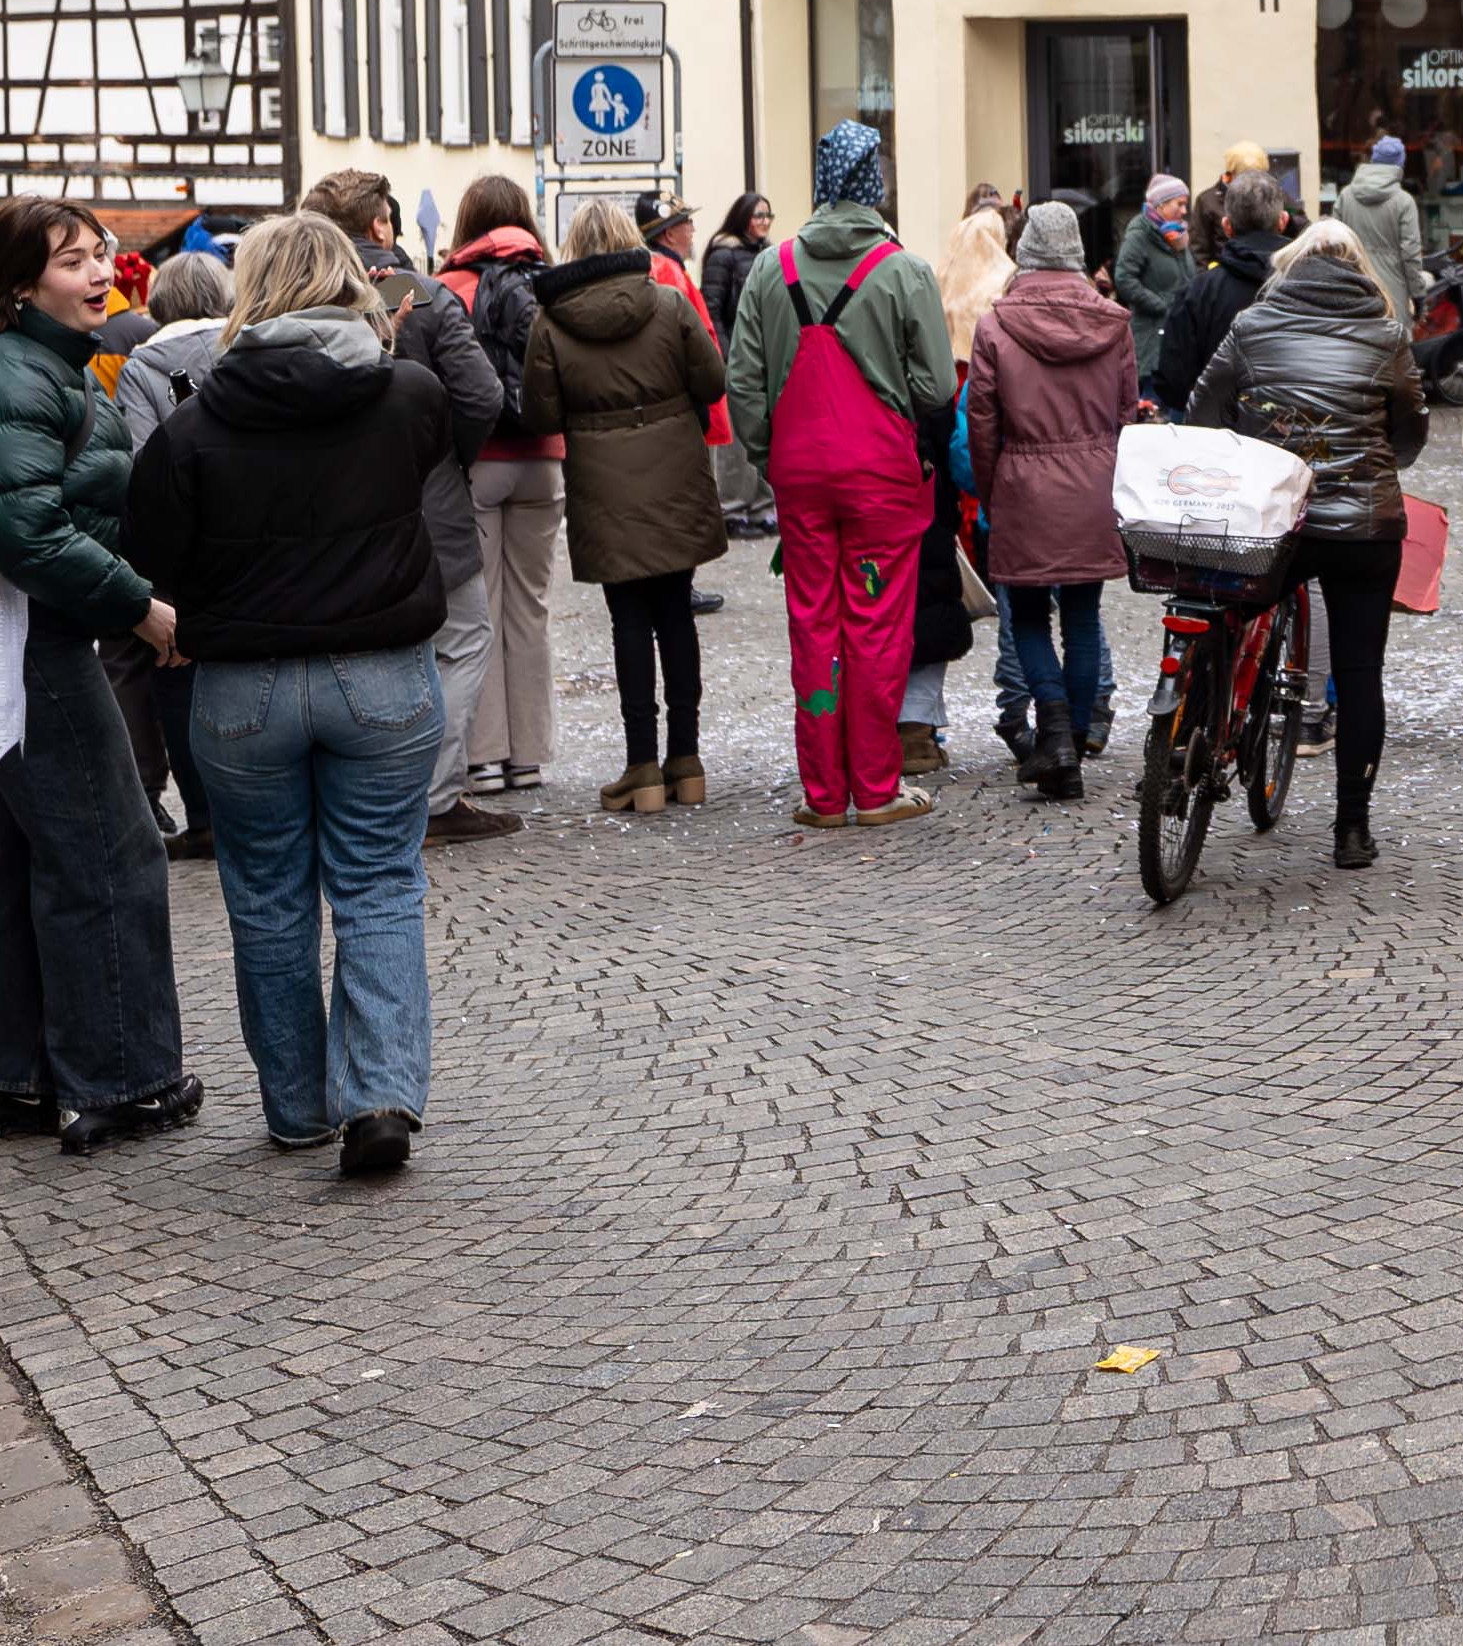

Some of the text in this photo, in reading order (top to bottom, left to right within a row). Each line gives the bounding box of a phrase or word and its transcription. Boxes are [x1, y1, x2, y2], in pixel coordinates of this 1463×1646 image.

[623, 15, 644, 26] frei
[559, 37, 661, 51] Schrittgeschwindigkeit
[1087, 114, 1124, 126] OPTIK
[1063, 116, 1145, 145] sikorski
[582, 139, 637, 157] ZONE
